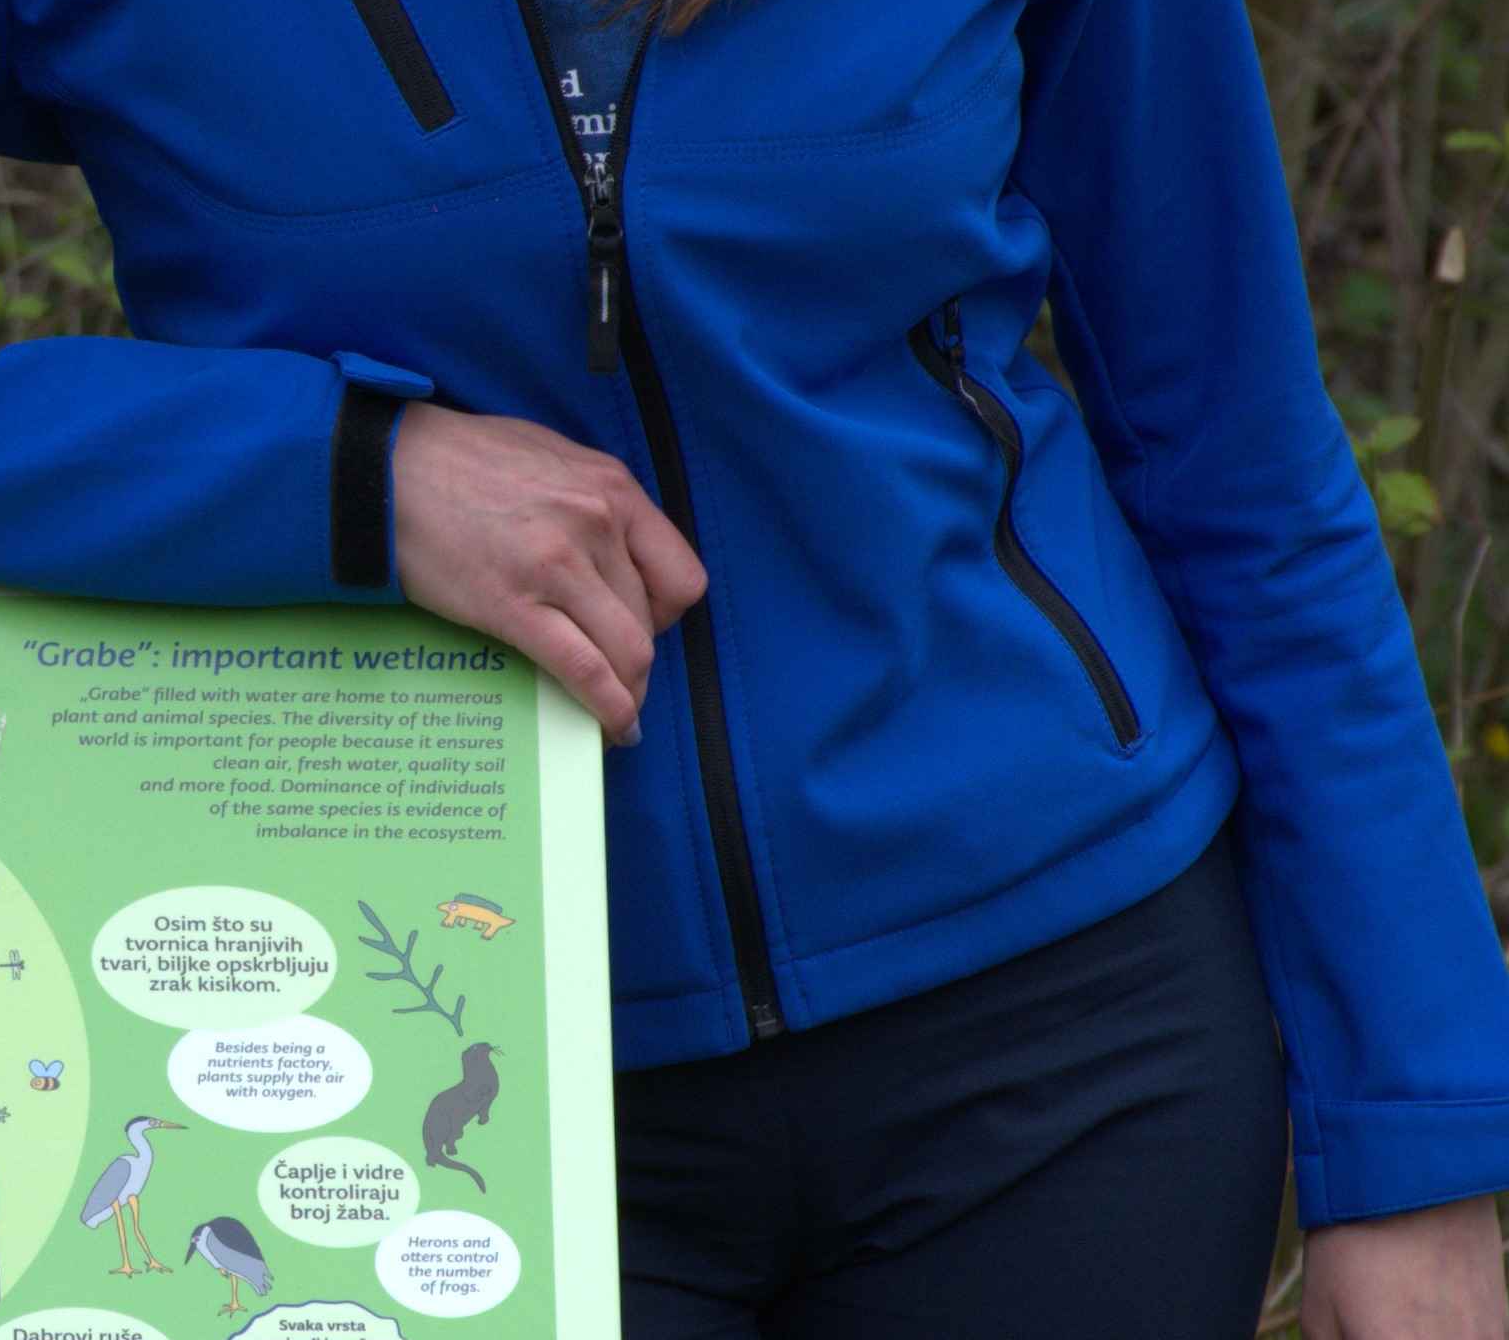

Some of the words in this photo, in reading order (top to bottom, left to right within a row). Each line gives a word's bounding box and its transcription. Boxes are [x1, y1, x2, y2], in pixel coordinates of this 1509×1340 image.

[172, 643, 344, 676] important
[353, 643, 507, 671] wetlands
[154, 686, 197, 705] filled
[201, 687, 241, 702] with
[245, 689, 298, 703] water
[301, 692, 331, 703] are
[332, 688, 386, 703] home
[390, 690, 410, 703] to
[414, 693, 503, 704] numerous
[256, 823, 349, 839] imbalance
[353, 824, 370, 839] in
[374, 823, 404, 840] the
[408, 825, 506, 844] ecosystem.
[154, 915, 207, 932] Osim
[212, 915, 245, 932] što
[250, 920, 273, 932] su
[125, 935, 209, 952] tvornica
[215, 935, 303, 956] hranjivih
[100, 955, 152, 974] tvari,
[158, 955, 211, 976] biljke
[216, 955, 329, 977] opskrbljuju
[149, 975, 193, 992] zrak
[198, 975, 281, 993] kisikom.
[274, 1159, 337, 1184] Čaplje
[342, 1164, 348, 1180] i
[352, 1163, 404, 1180] vidre
[280, 1182, 400, 1205] kontroliraju
[290, 1203, 331, 1224] broj
[336, 1203, 390, 1221] žaba.
[408, 1235, 459, 1248] Herons
[462, 1236, 491, 1249] and
[400, 1251, 443, 1263] otters
[446, 1250, 499, 1263] control
[408, 1265, 432, 1277] the
[436, 1265, 493, 1278] number
[420, 1279, 437, 1295] of
[439, 1279, 480, 1296] frogs.
[279, 1318, 324, 1332] Svaka
[327, 1320, 366, 1332] vrsta
